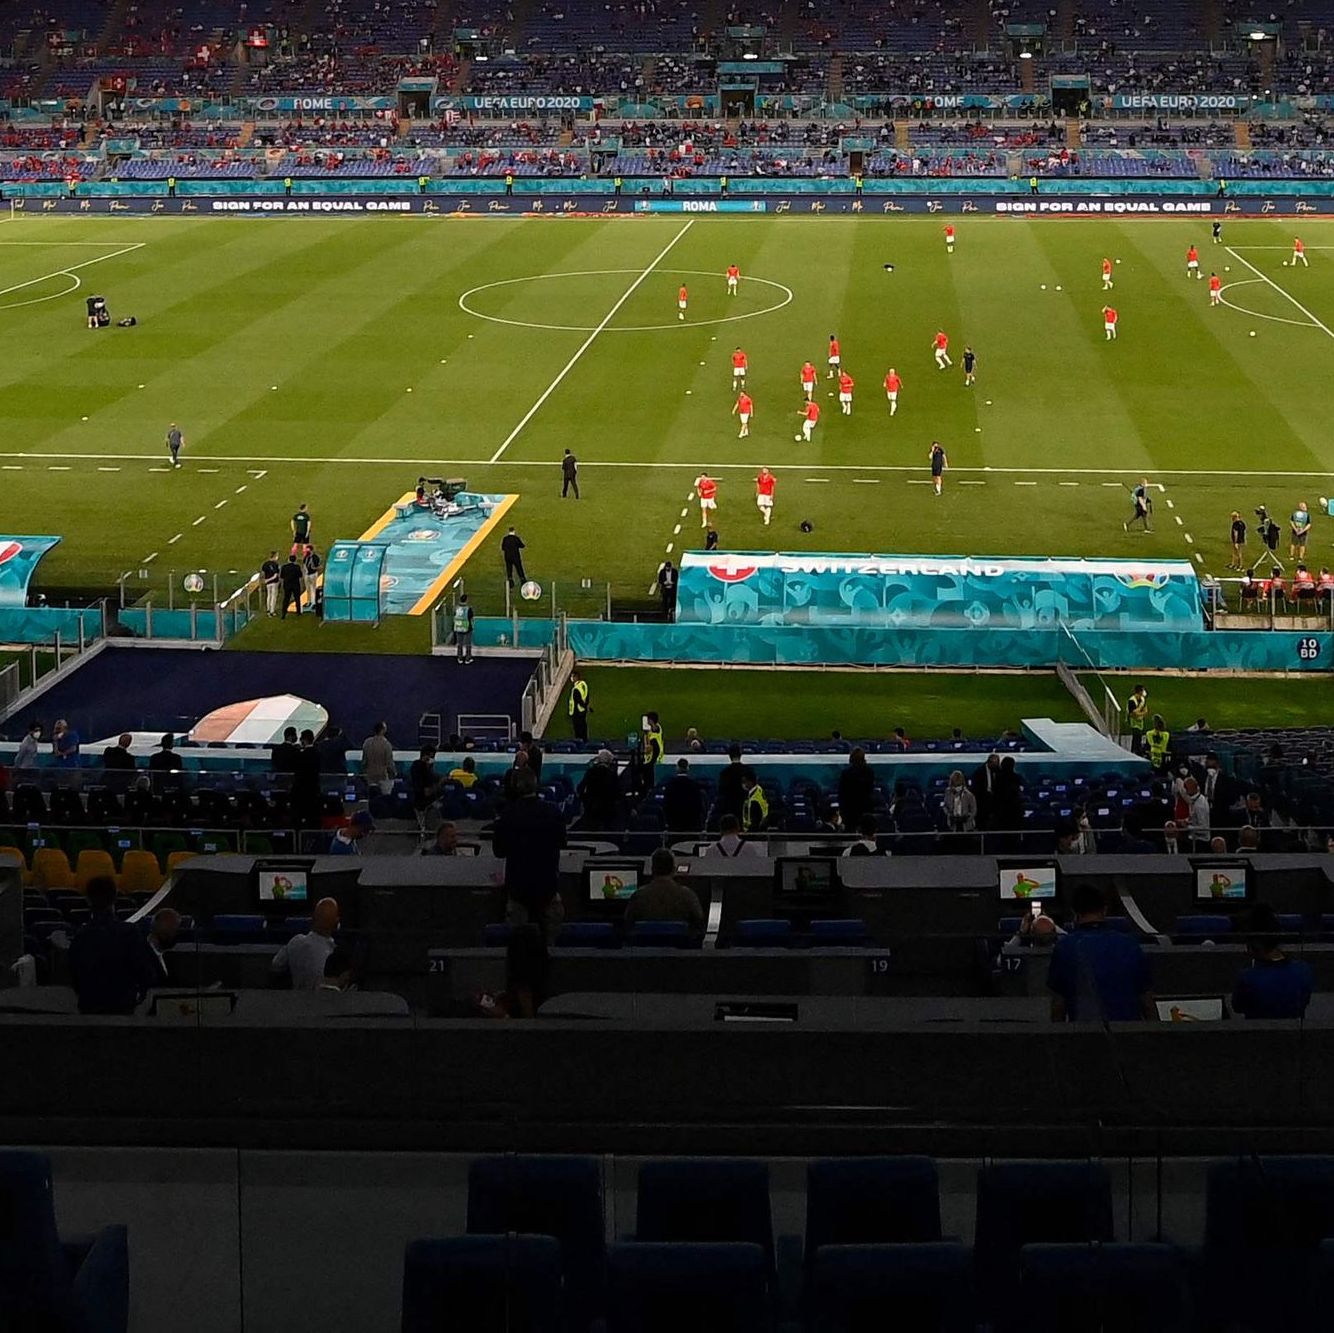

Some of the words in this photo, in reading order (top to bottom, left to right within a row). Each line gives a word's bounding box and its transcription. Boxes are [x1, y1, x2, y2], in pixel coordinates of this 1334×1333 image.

[294, 99, 332, 109] ROME
[474, 97, 508, 108] UEFA
[547, 97, 580, 108] 2020
[1122, 96, 1158, 107] UEFA
[1160, 96, 1198, 107] EURO
[1200, 96, 1235, 107] 2020
[212, 201, 250, 211] SIGN
[252, 201, 284, 211] FOR
[287, 201, 309, 211] AN
[312, 201, 363, 212] EQUAL
[365, 201, 411, 211] GAME
[682, 201, 717, 212] ROMA
[996, 202, 1038, 212] SIGN
[1040, 202, 1074, 212] FOR
[1076, 202, 1101, 212] AN
[1104, 202, 1159, 213] EQUAL
[1162, 202, 1211, 212] GAME
[781, 561, 1005, 577] SWITZERLAND
[1301, 639, 1316, 648] 10
[1300, 648, 1317, 658] BD
[429, 960, 445, 973] 21
[871, 959, 888, 972] 19
[1005, 958, 1021, 971] 17
